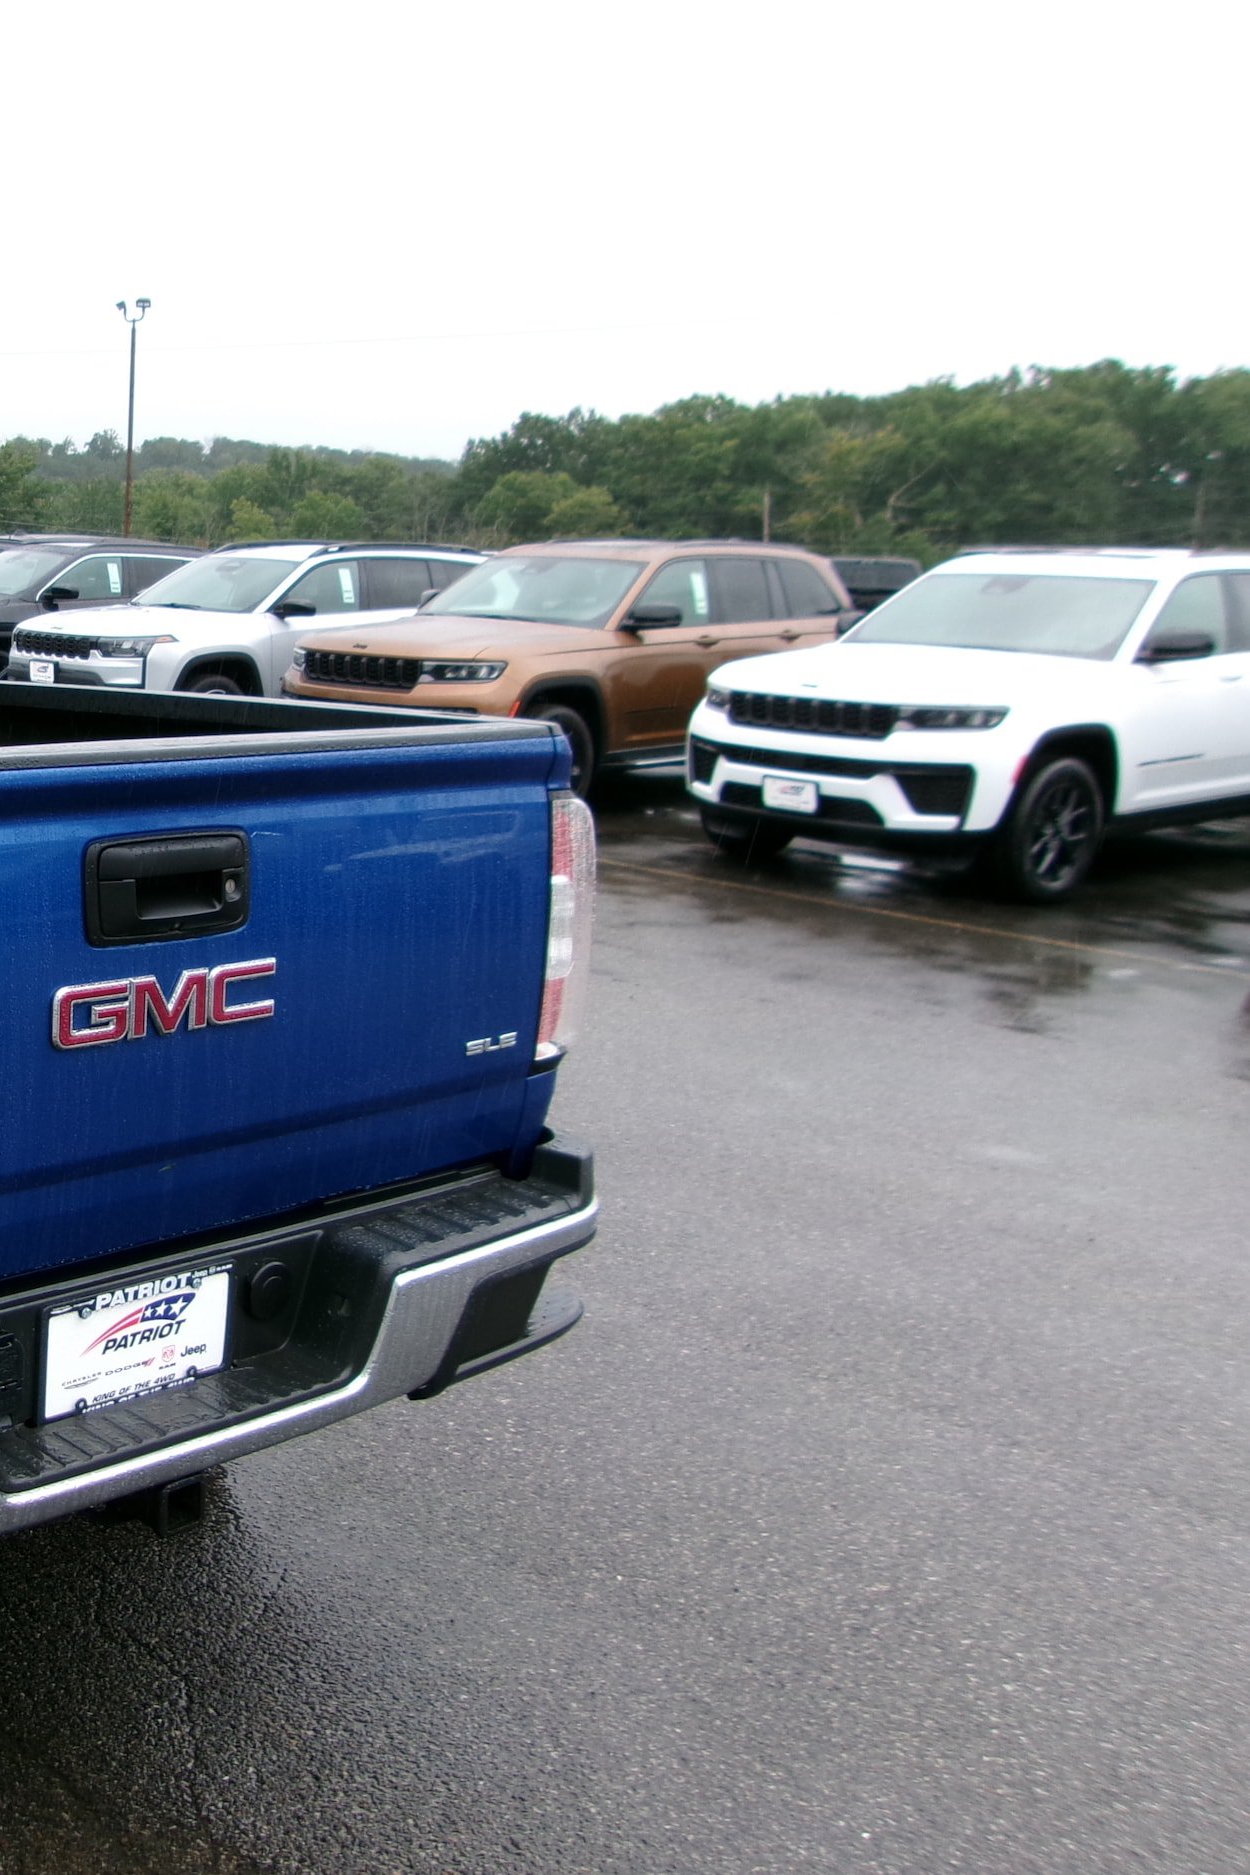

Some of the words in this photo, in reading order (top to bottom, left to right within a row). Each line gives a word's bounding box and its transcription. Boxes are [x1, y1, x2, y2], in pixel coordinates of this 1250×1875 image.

[51, 957, 277, 1051] GMC
[466, 1031, 518, 1056] SLE
[95, 1272, 192, 1311] PATRIOT
[102, 1319, 187, 1355] PATRIOT
[180, 1343, 207, 1358] Jeep
[92, 1389, 117, 1403] KING
[118, 1386, 132, 1396] OF
[134, 1380, 151, 1390] THE
[153, 1373, 176, 1386] 4WD
